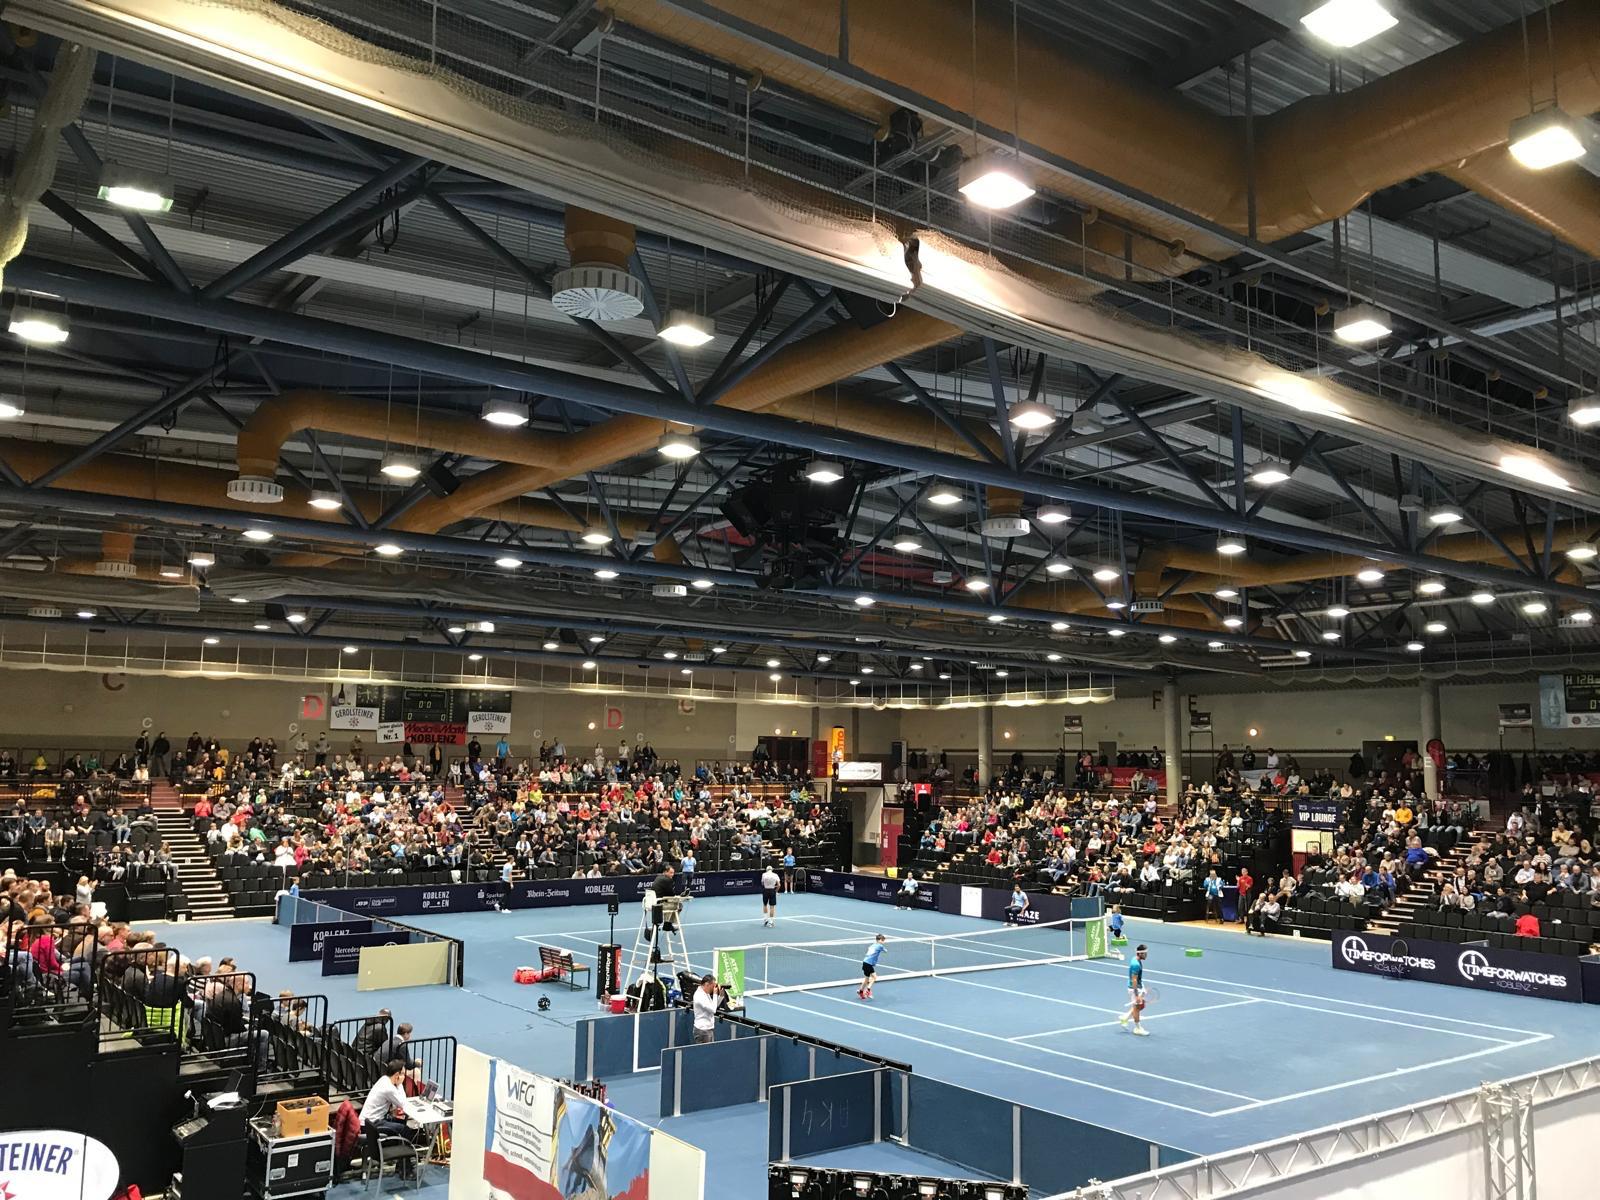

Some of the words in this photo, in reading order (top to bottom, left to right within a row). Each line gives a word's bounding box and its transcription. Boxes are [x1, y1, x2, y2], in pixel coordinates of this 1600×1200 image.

[1152, 690, 1162, 709] F
[1188, 694, 1198, 713] E
[304, 694, 324, 719] D
[335, 708, 374, 719] GEROLSTEINER
[471, 713, 508, 724] GEROLSTEINER
[608, 708, 623, 729] D
[142, 717, 153, 728] C
[289, 722, 298, 733] C
[394, 732, 399, 740] 1
[408, 733, 457, 744] KOBLENZ
[1424, 756, 1433, 768] E
[1298, 812, 1310, 822] VIP
[1311, 813, 1337, 824] LOUNGE
[526, 888, 570, 898] Rhein-Zeitung
[584, 884, 616, 894] KOBLENZ
[422, 891, 450, 900] KOBLENZ
[1464, 961, 1567, 987] TIMEFORWATCHES
[1496, 980, 1531, 991] KOBLENZ
[507, 1074, 536, 1107] WFG
[0, 1143, 73, 1175] TEINER
